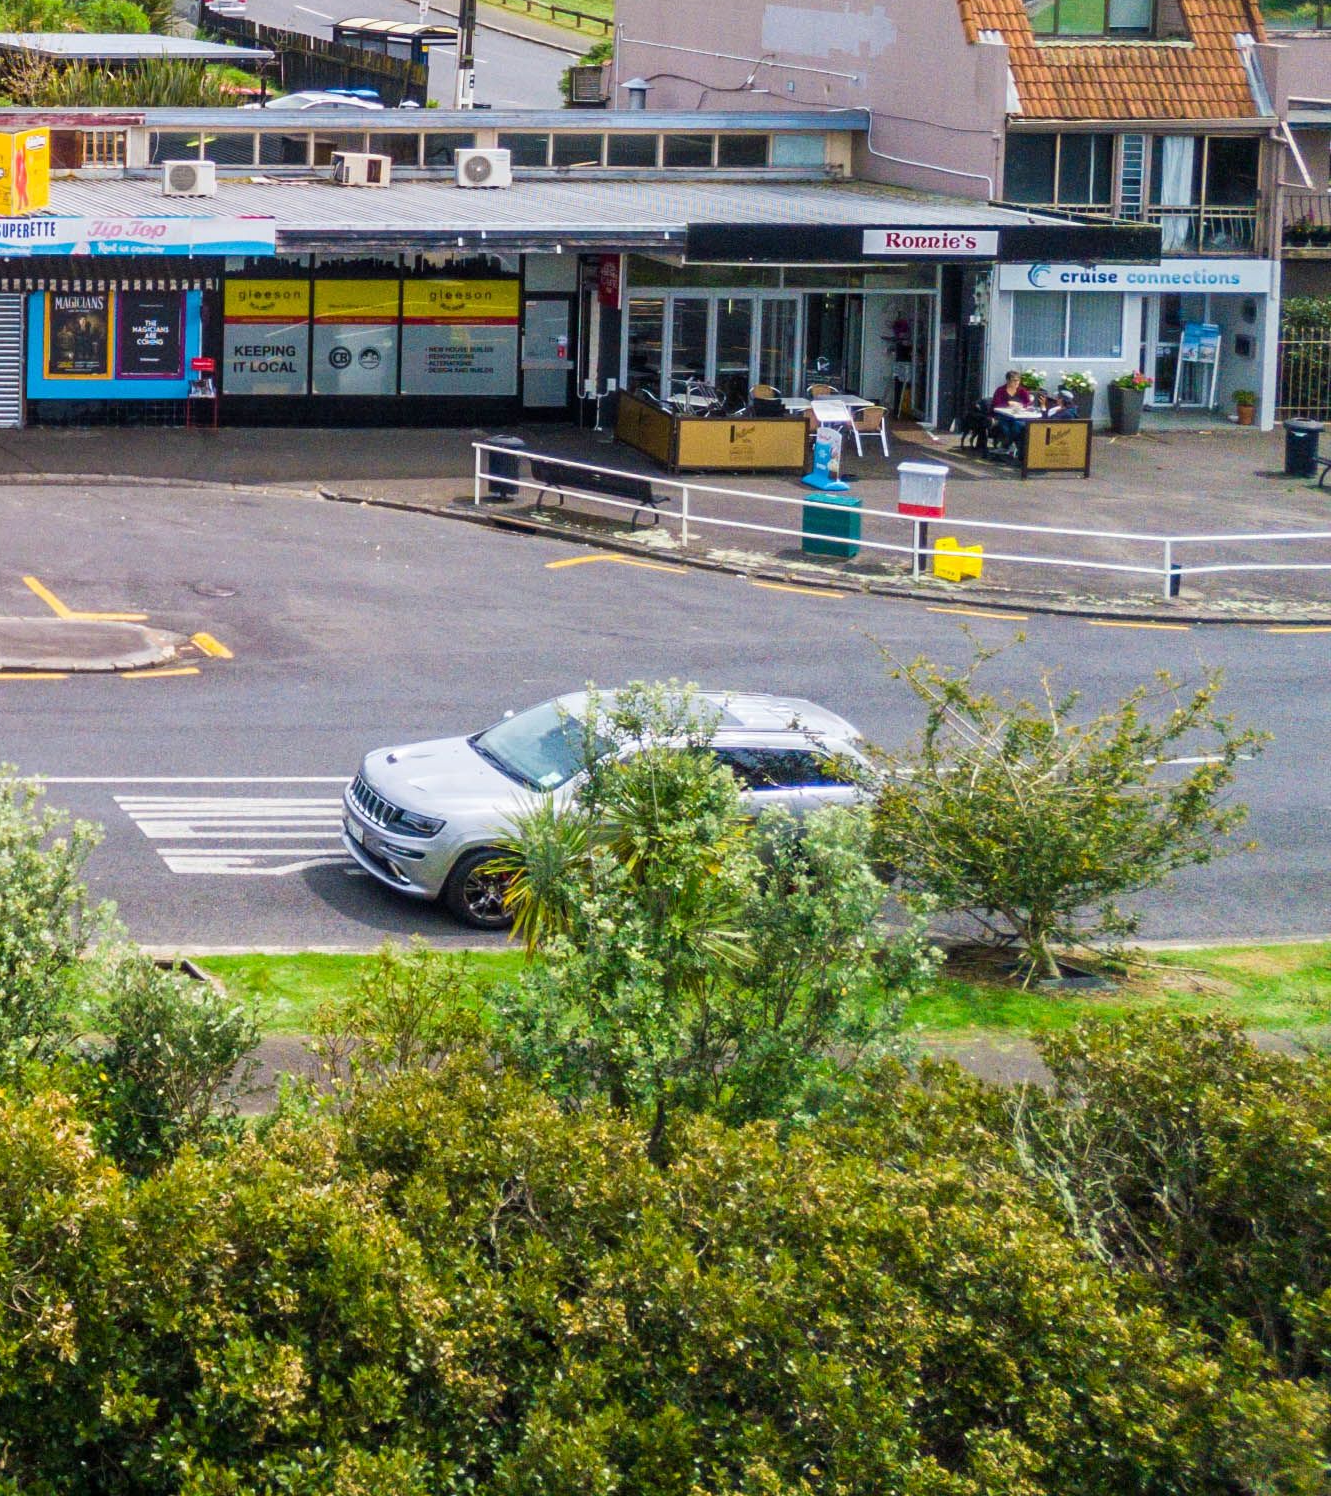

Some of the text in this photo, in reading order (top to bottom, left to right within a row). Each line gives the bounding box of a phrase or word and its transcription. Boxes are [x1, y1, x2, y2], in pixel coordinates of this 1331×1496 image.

[88, 220, 167, 239] Tip Top
[885, 231, 977, 249] Ronnie's
[1060, 266, 1241, 284] cruise connections
[239, 290, 301, 301] gleeson
[430, 291, 492, 301] gleeson
[55, 296, 104, 310] MAGICIANS
[234, 345, 296, 357] KEEPING
[233, 362, 297, 373] IT LOCAL
